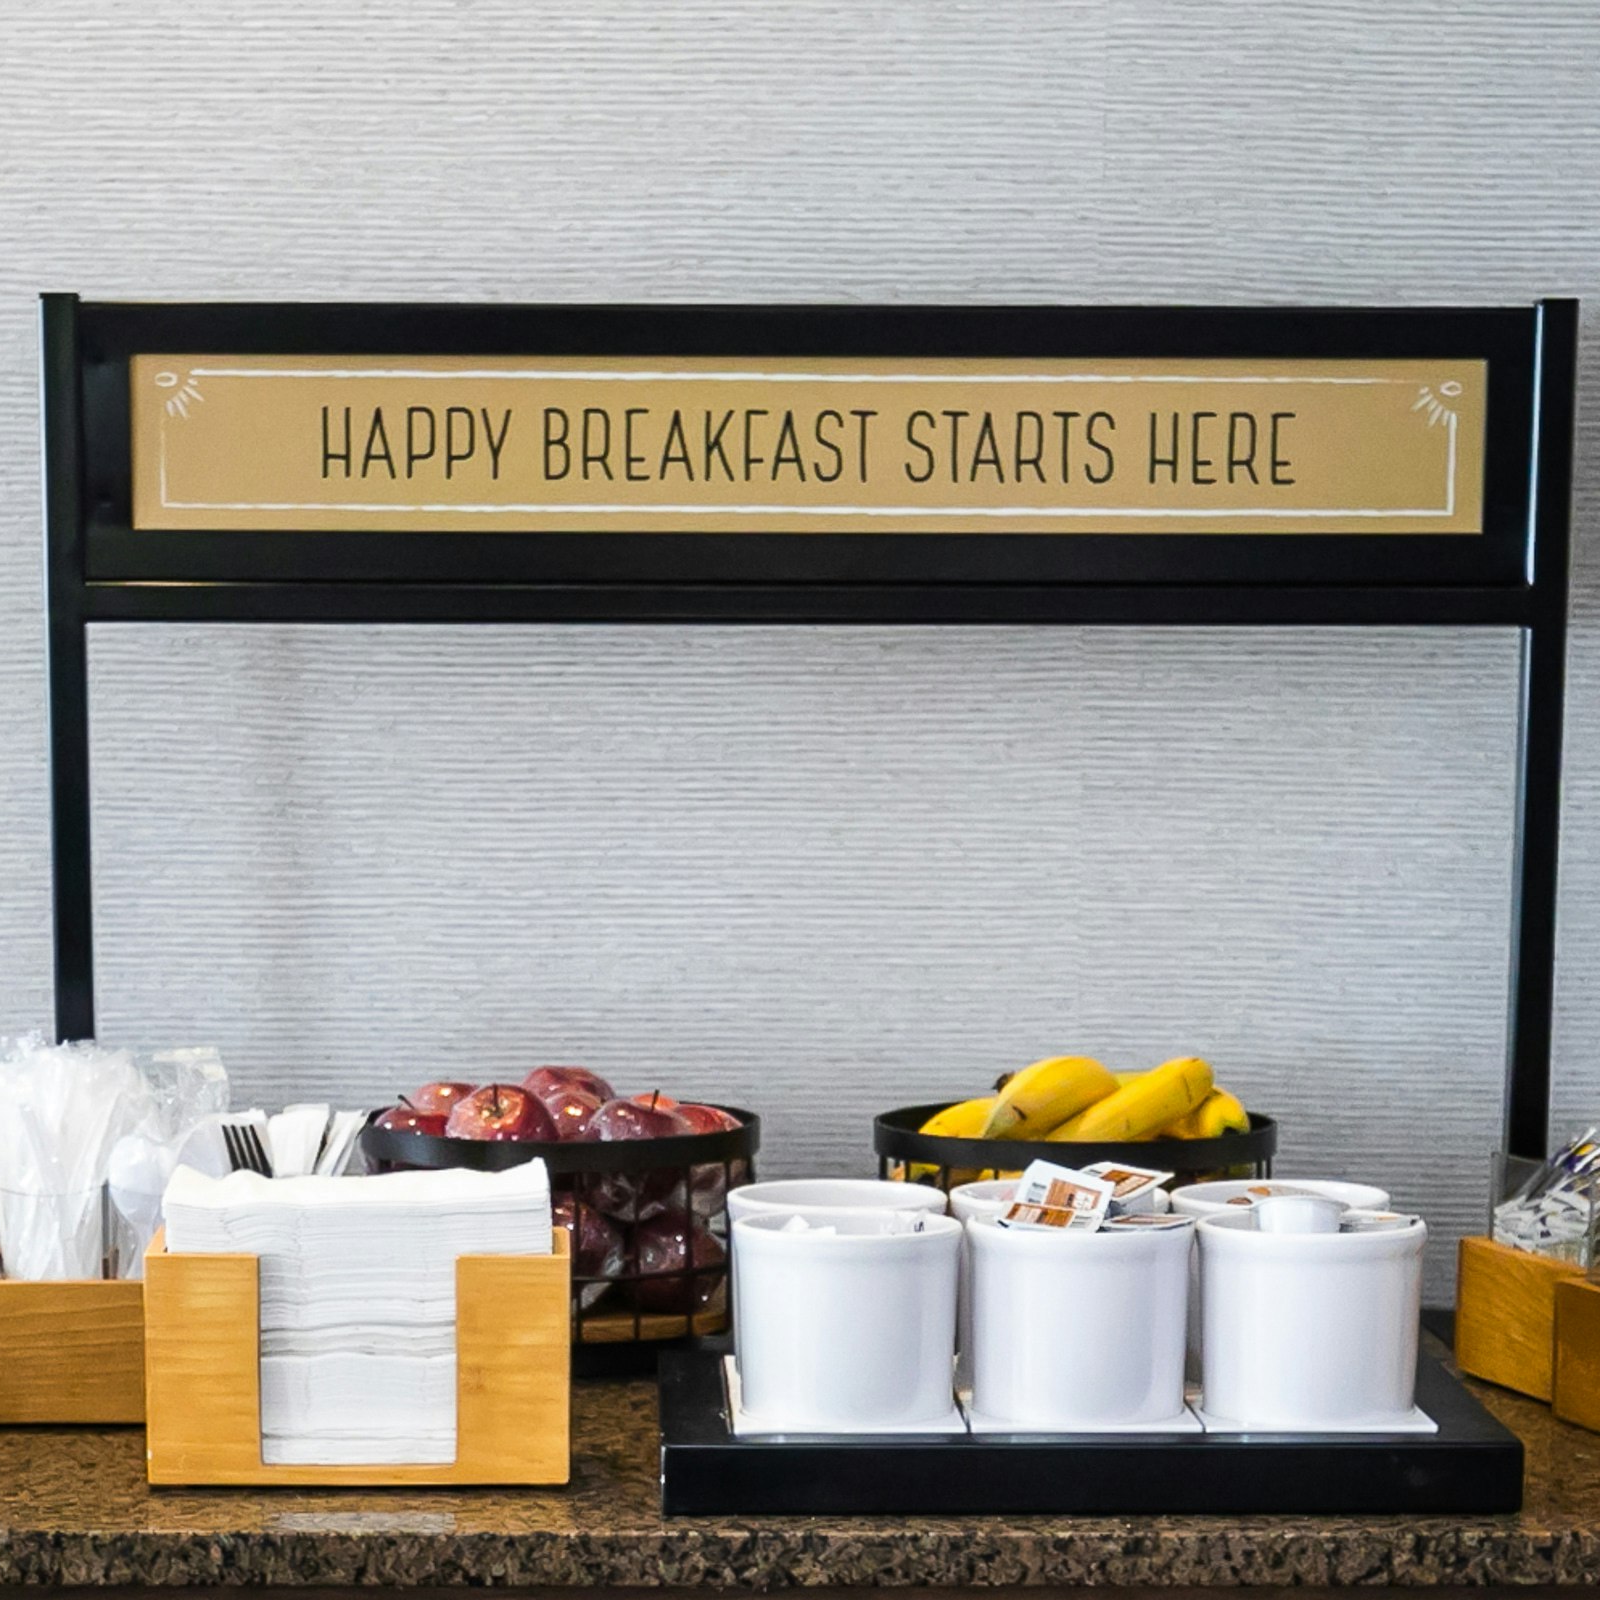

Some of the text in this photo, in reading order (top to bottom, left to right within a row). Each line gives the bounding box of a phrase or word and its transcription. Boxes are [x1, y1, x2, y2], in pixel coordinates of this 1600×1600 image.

[321, 405, 1297, 486] HAPPY BREAKFAST STARTS HERE
